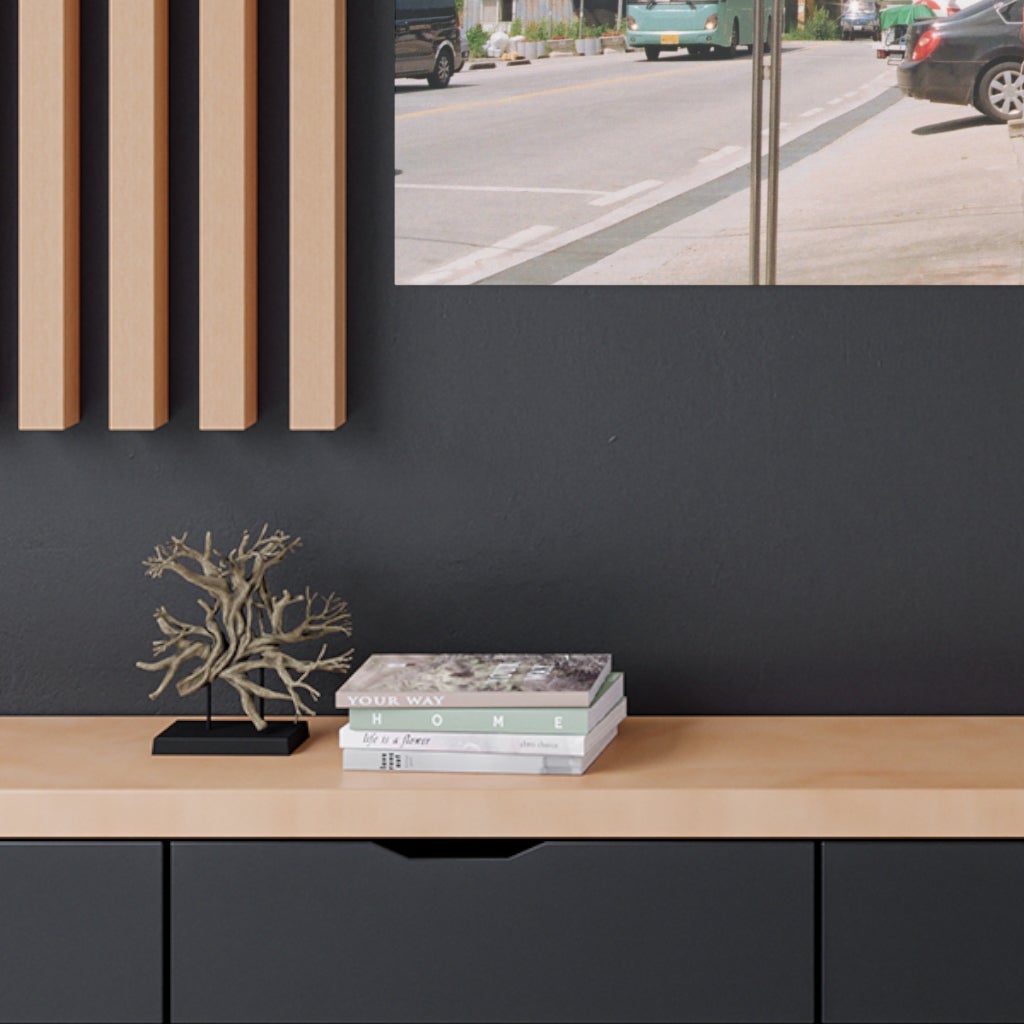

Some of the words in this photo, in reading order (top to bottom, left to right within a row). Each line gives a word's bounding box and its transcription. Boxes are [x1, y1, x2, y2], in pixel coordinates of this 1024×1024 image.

[348, 696, 400, 706] YOUR
[406, 696, 445, 706] WAY
[372, 713, 563, 729] HOME
[363, 732, 377, 746] life
[401, 734, 431, 747] flower
